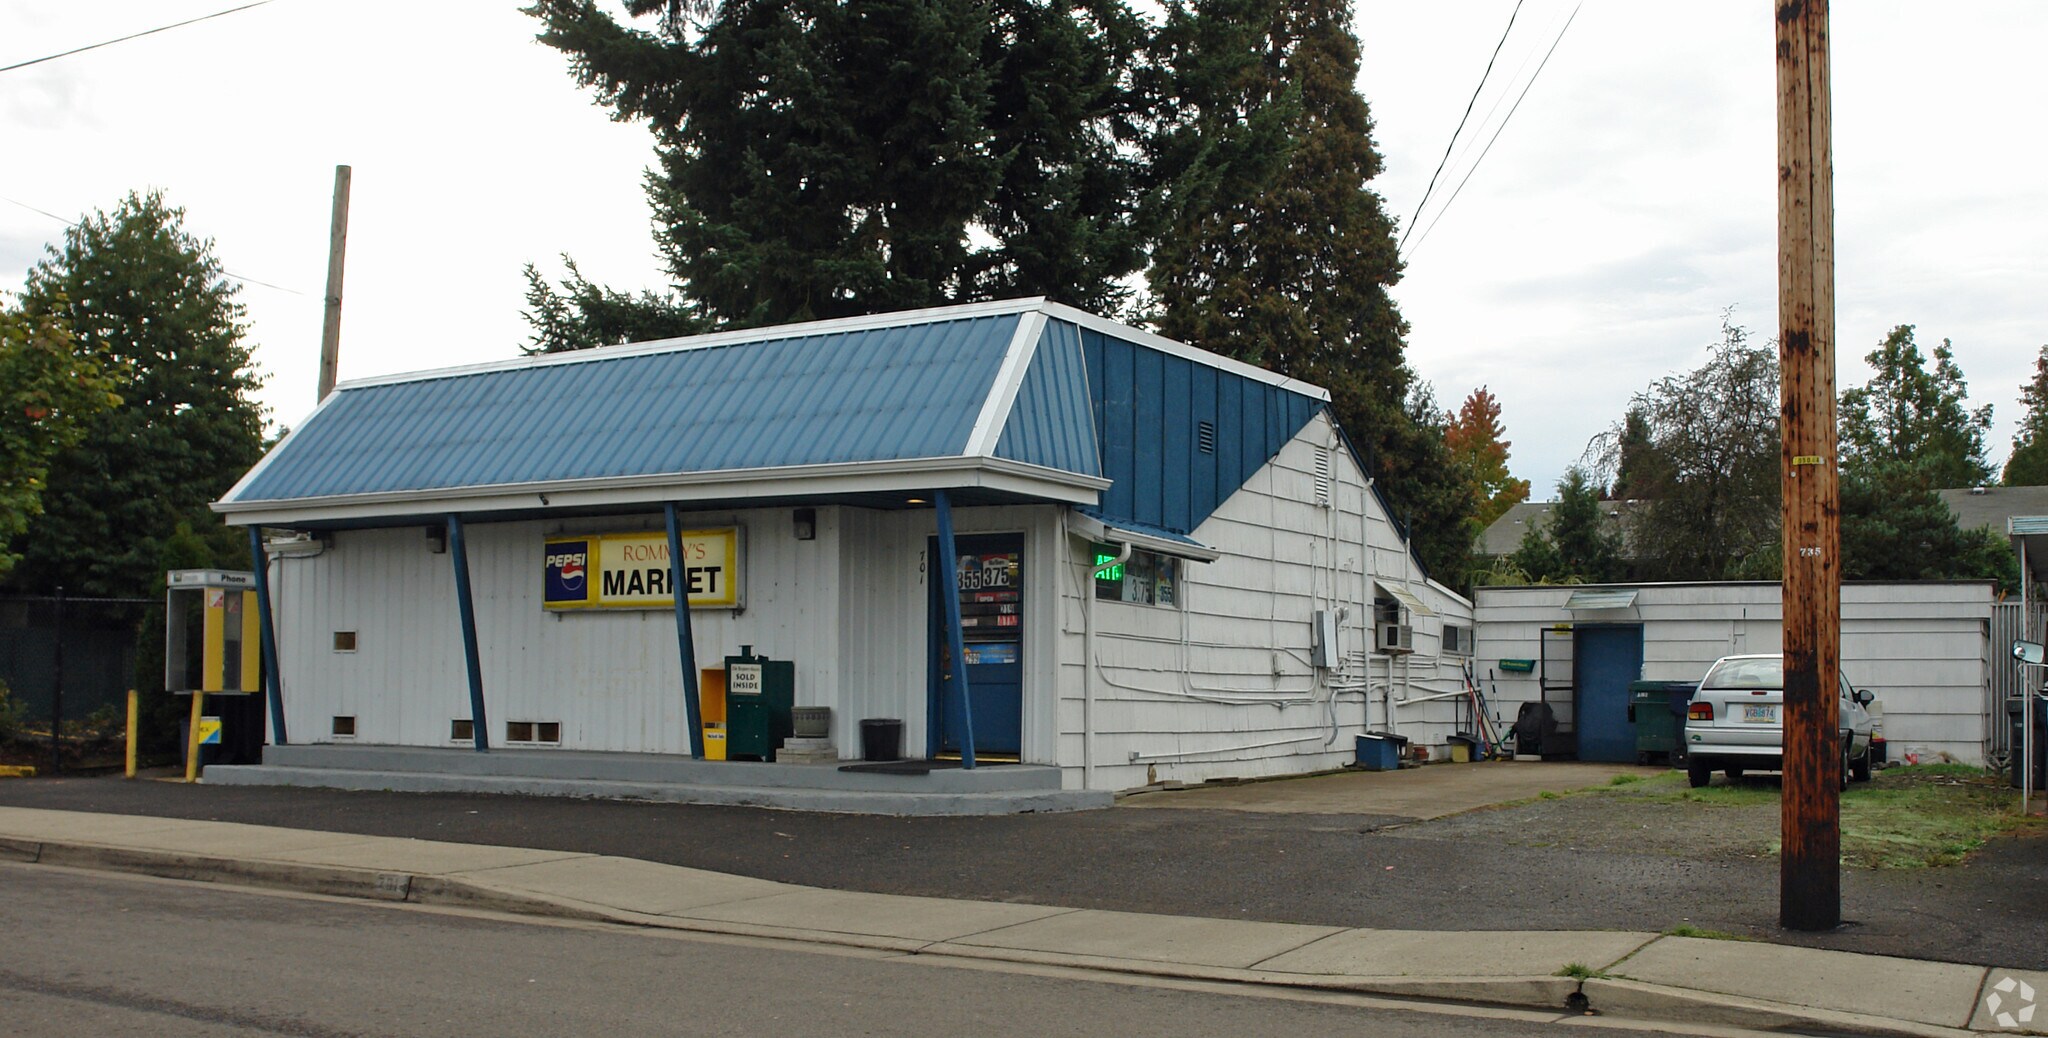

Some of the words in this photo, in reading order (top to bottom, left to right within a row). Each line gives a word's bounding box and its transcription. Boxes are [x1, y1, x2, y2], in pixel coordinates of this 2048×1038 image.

[1799, 547, 1821, 557] 735
[545, 553, 586, 568] PEPSI
[221, 574, 246, 584] Phone
[957, 570, 981, 589] 355
[984, 566, 1009, 586] 375
[736, 673, 755, 681] SOLD
[733, 681, 758, 689] INSIDE
